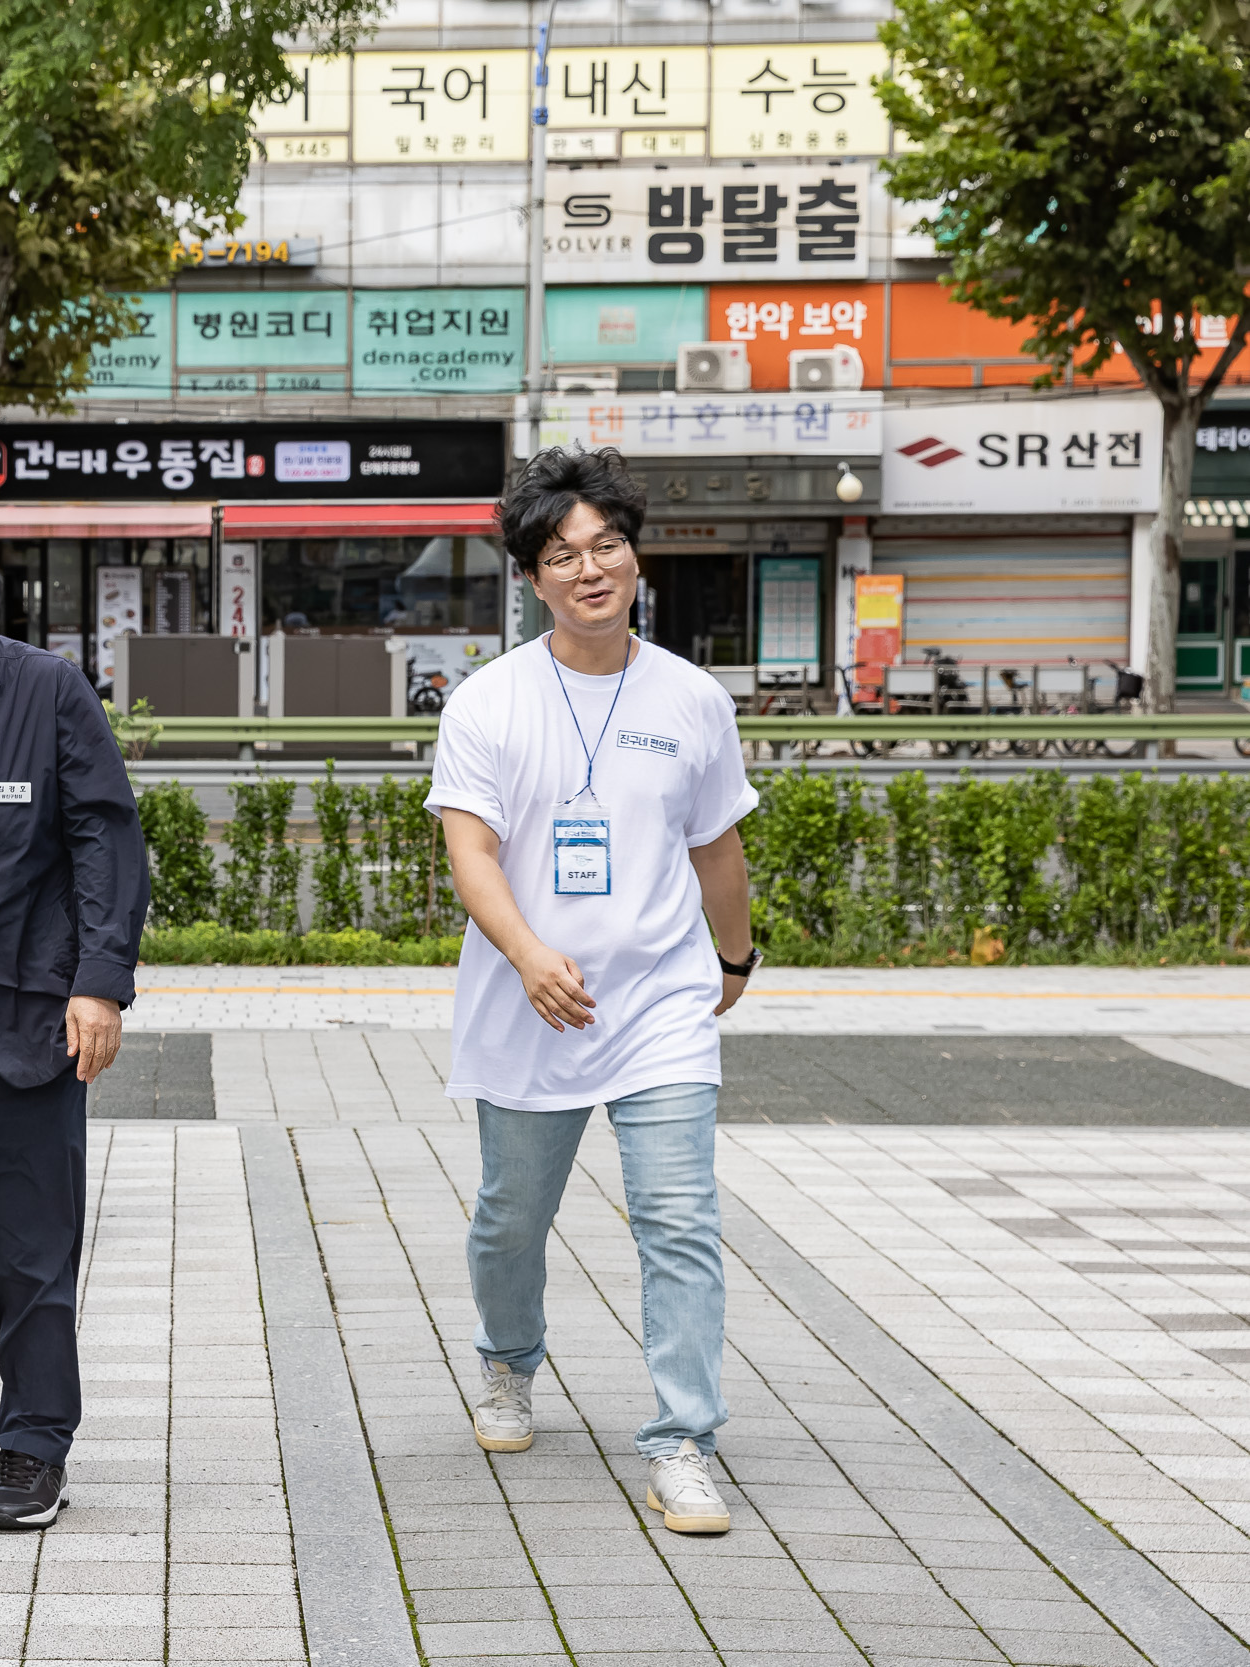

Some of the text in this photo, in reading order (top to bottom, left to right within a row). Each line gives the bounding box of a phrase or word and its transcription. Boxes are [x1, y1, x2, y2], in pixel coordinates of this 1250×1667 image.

[382, 65, 488, 121] 국어
[563, 60, 666, 117] 내신
[740, 58, 857, 114] 수능
[648, 179, 860, 265] 방탈출
[542, 236, 633, 254] SOLVER
[193, 311, 332, 340] 병원코디
[368, 308, 510, 337] 취업지원
[725, 300, 868, 341] 한약 보약
[362, 348, 516, 367] denacademy
[411, 365, 467, 383] .com
[13, 439, 246, 490] 건대우동집
[977, 431, 1143, 469] SR 산전
[650, 738, 677, 753] 편의점
[568, 871, 598, 879] STAFF
